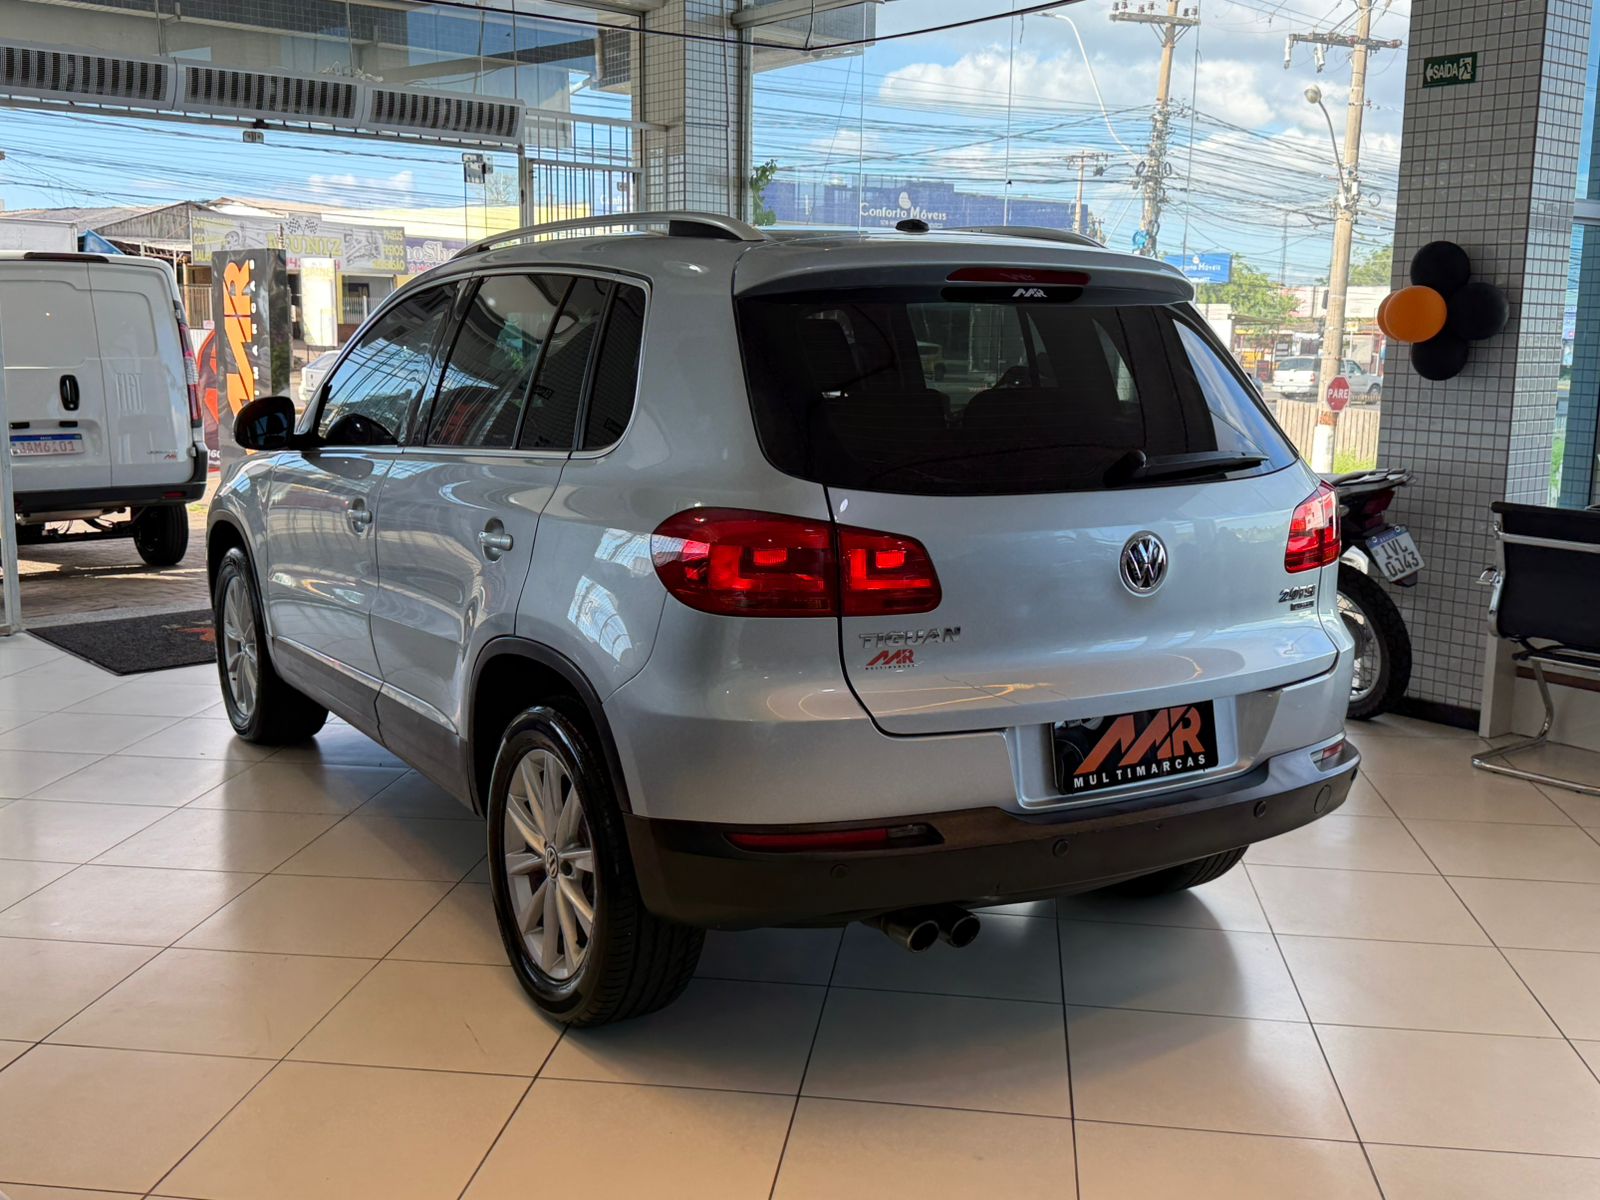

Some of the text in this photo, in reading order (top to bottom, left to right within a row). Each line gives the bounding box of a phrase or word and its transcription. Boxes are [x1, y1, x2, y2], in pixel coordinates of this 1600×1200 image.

[1433, 61, 1459, 79] SAÍDA
[860, 202, 947, 220] Conforto Móveis
[1327, 388, 1349, 399] PARE
[1381, 538, 1408, 560] IVL
[859, 626, 961, 649] TIGUAN
[1074, 755, 1206, 788] MULTIMARCAS
